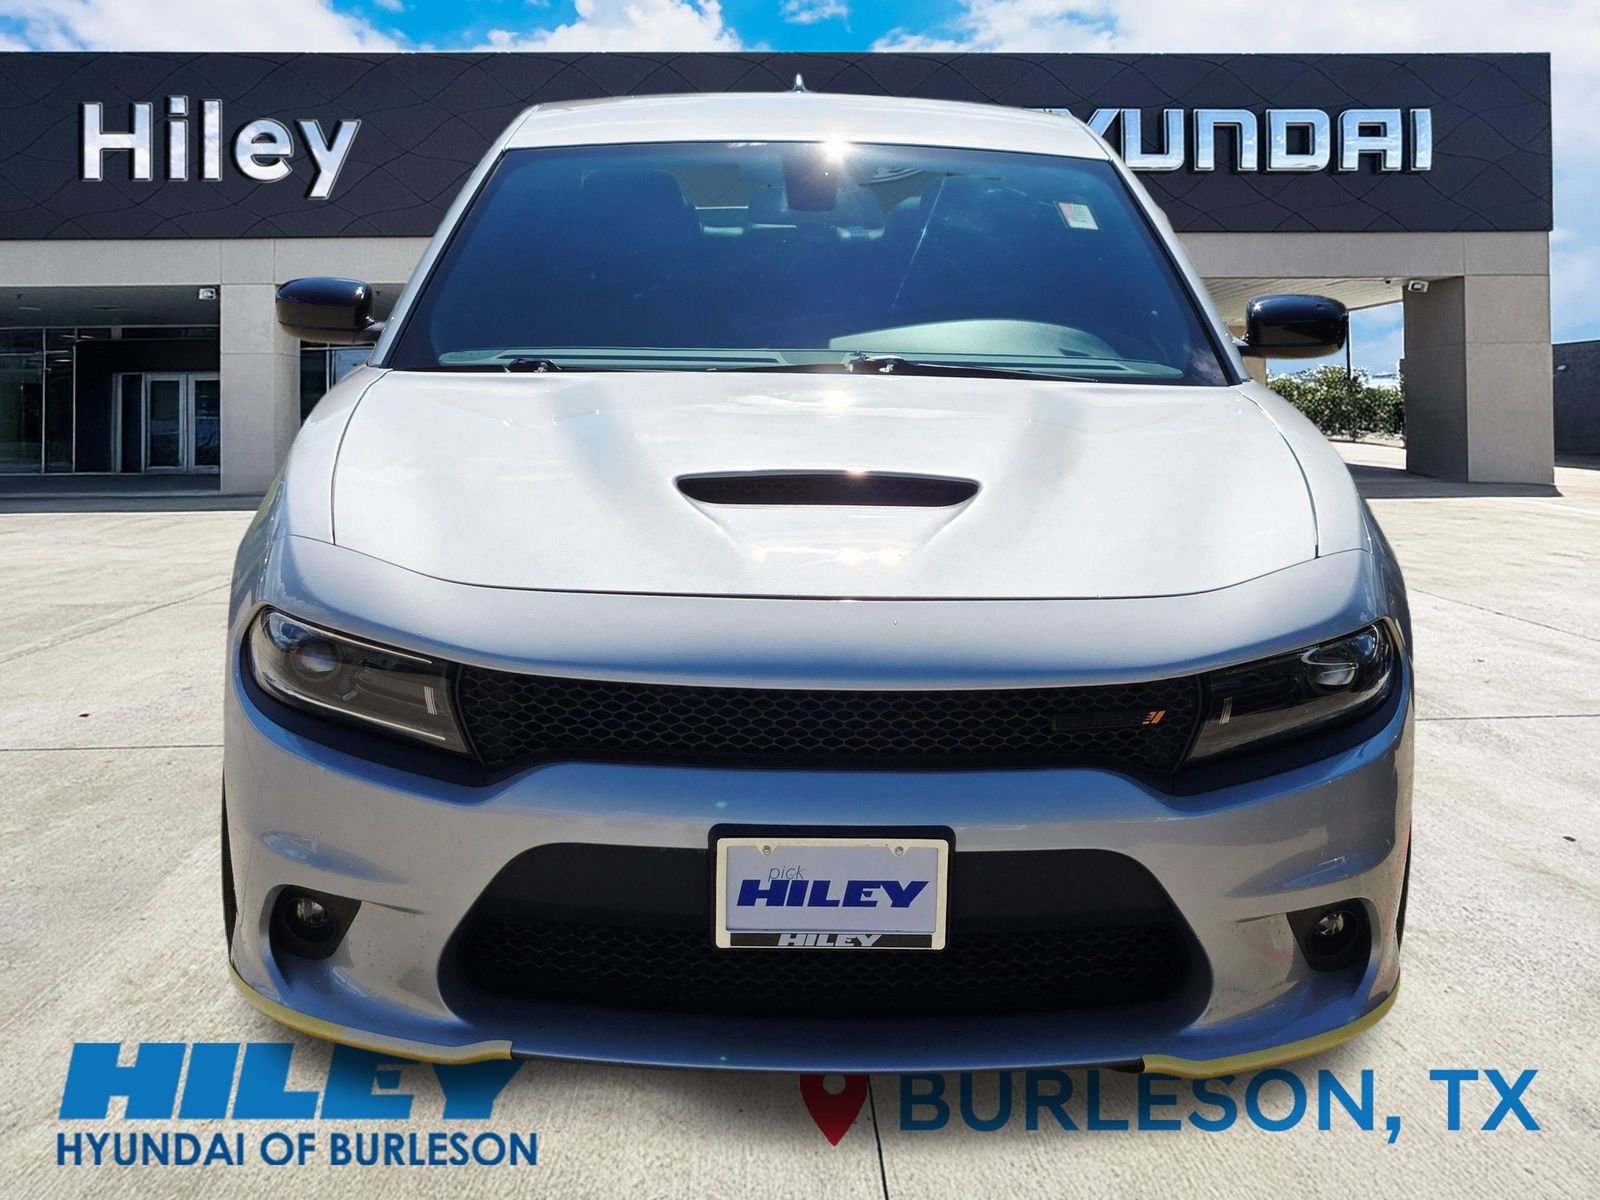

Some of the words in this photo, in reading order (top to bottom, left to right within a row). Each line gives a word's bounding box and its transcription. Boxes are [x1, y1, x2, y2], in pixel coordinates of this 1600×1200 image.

[80, 95, 362, 200] Hiley
[1024, 108, 1433, 172] UNDAI
[767, 865, 806, 883] pick
[736, 879, 930, 908] HILEY
[777, 932, 883, 948] HILEY
